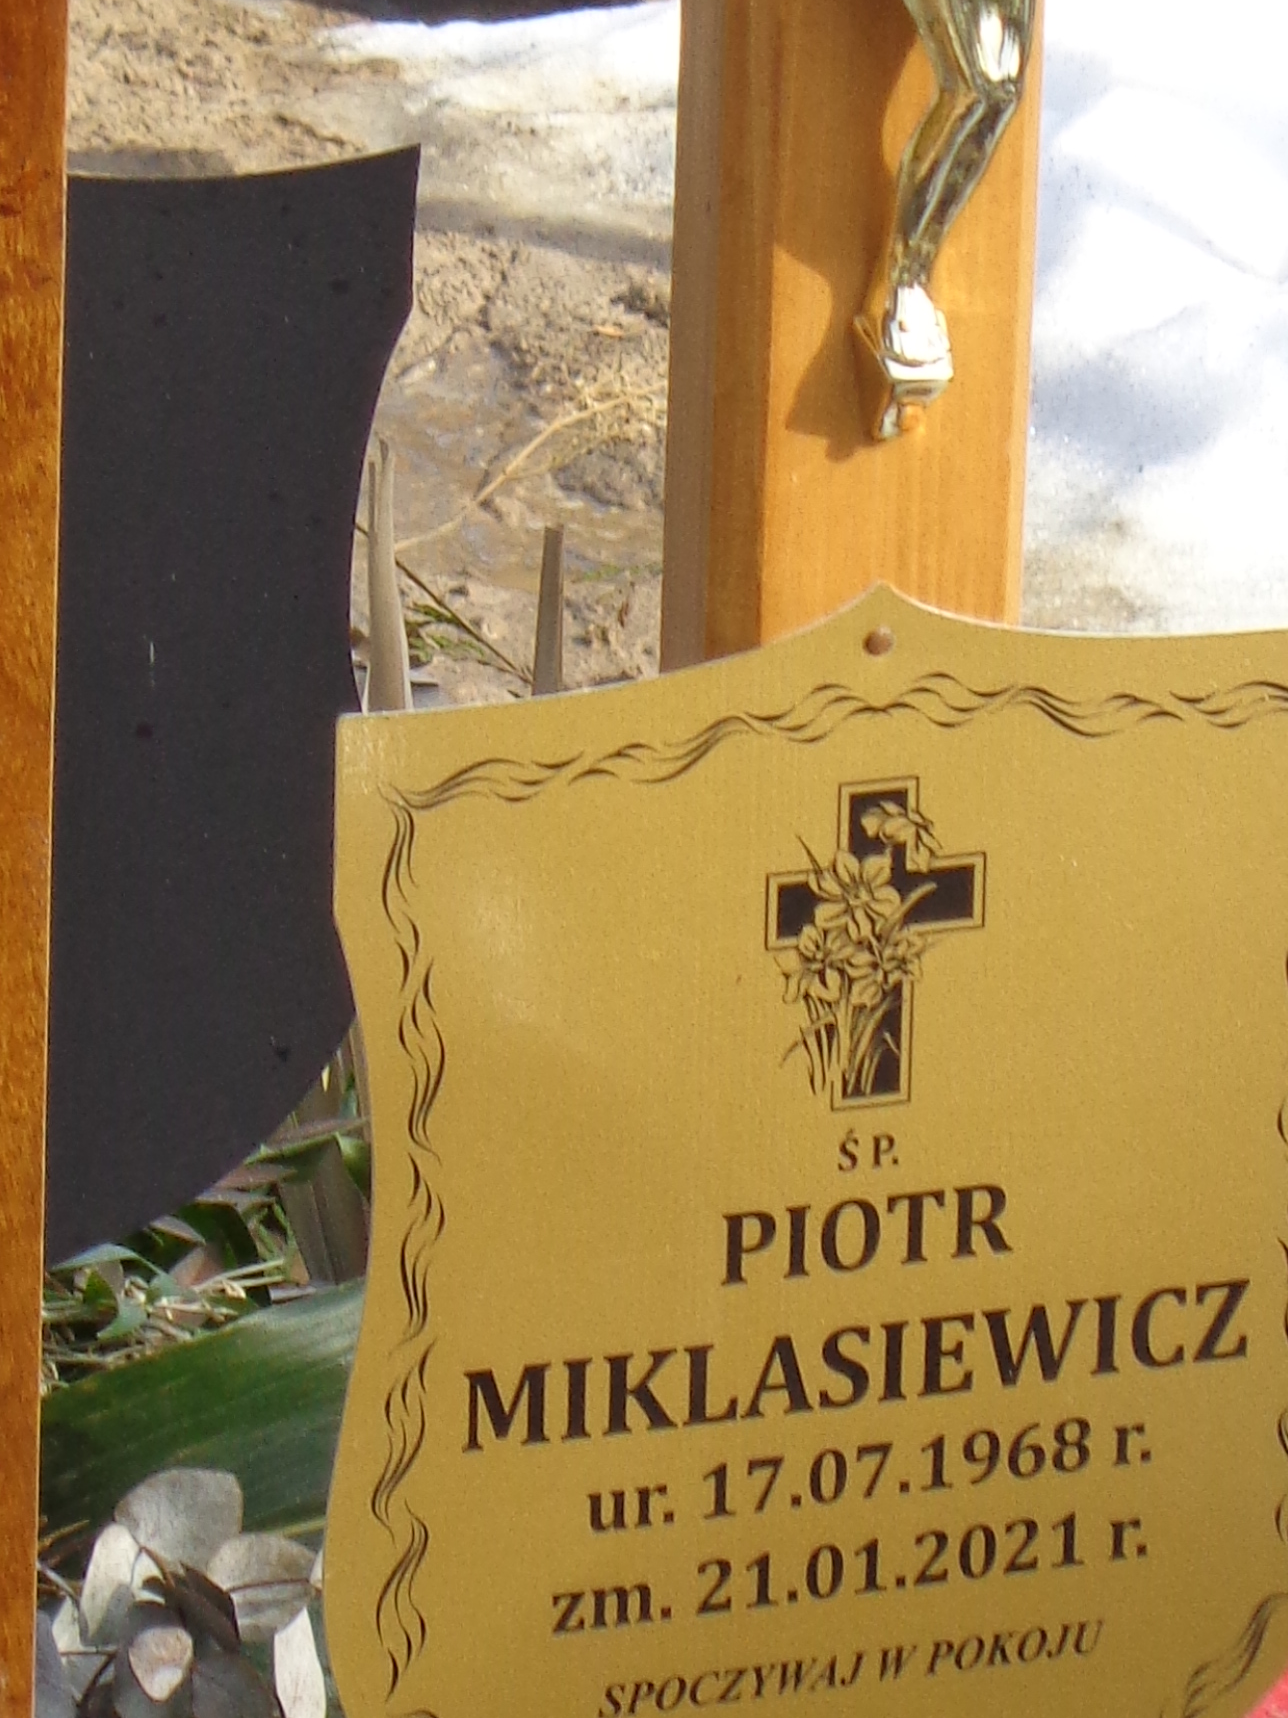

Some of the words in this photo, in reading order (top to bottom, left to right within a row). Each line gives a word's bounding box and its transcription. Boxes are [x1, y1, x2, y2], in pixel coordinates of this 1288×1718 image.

[721, 1184, 1013, 1286] PIOTR
[463, 1279, 1251, 1453] MIKLASIEWICZ
[588, 1483, 675, 1532] ur.
[703, 1418, 1091, 1520] 17.07.1968
[1113, 1422, 1151, 1465] r.
[552, 1583, 672, 1633] zm.
[697, 1512, 1084, 1615] 21.01.2021
[1110, 1517, 1147, 1560] r.
[598, 1651, 864, 1718] SPOCZYWAJ
[879, 1644, 918, 1680] W
[926, 1619, 1104, 1676] POKOJU
